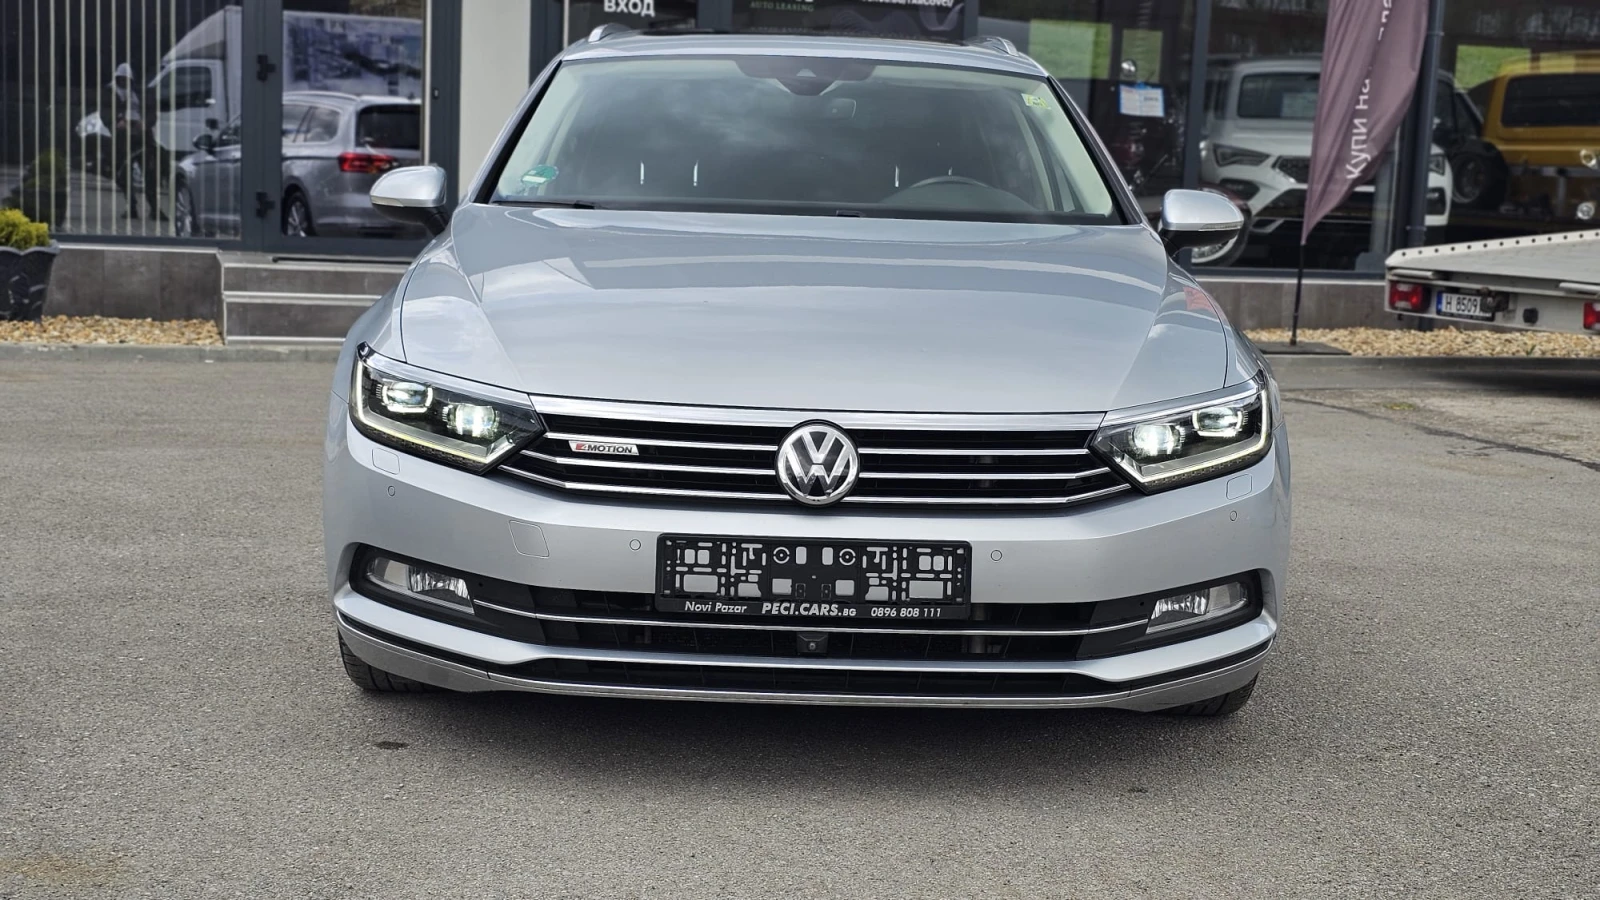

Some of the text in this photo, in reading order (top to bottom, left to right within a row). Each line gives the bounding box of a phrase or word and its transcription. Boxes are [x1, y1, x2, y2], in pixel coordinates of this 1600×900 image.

[604, 0, 656, 17] ВХОД
[749, 1, 815, 12] AUTO LEASING
[1345, 118, 1371, 179] Купи
[1456, 296, 1478, 313] 8509
[684, 601, 942, 617] Novi Pazar PECI.CARS.BG 0896 808 111
